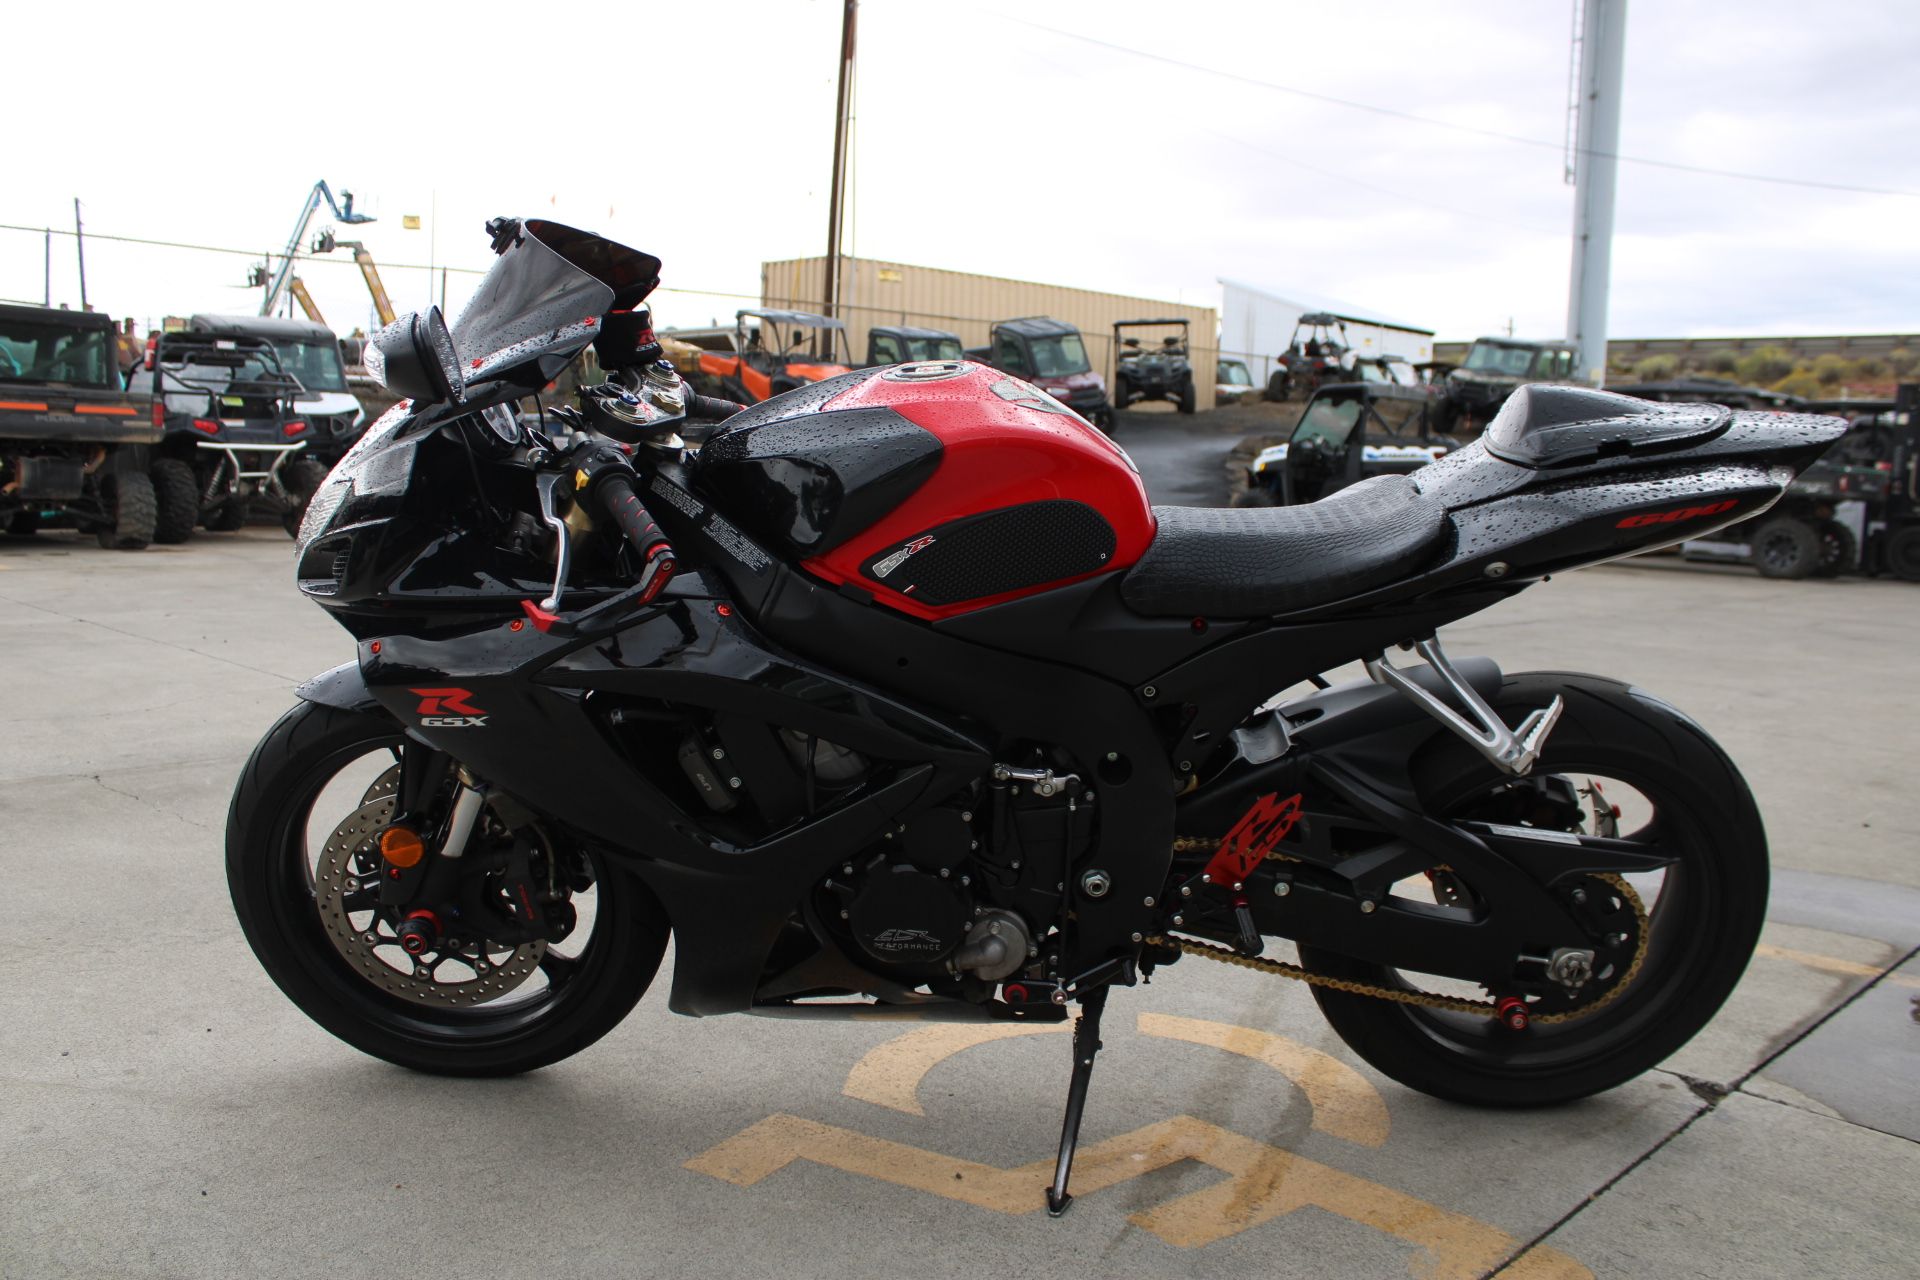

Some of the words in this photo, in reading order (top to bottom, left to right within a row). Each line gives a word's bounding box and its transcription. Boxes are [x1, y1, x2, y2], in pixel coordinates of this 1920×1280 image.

[1615, 499, 1739, 528] 600
[407, 688, 488, 715] R
[421, 716, 490, 727] GSX
